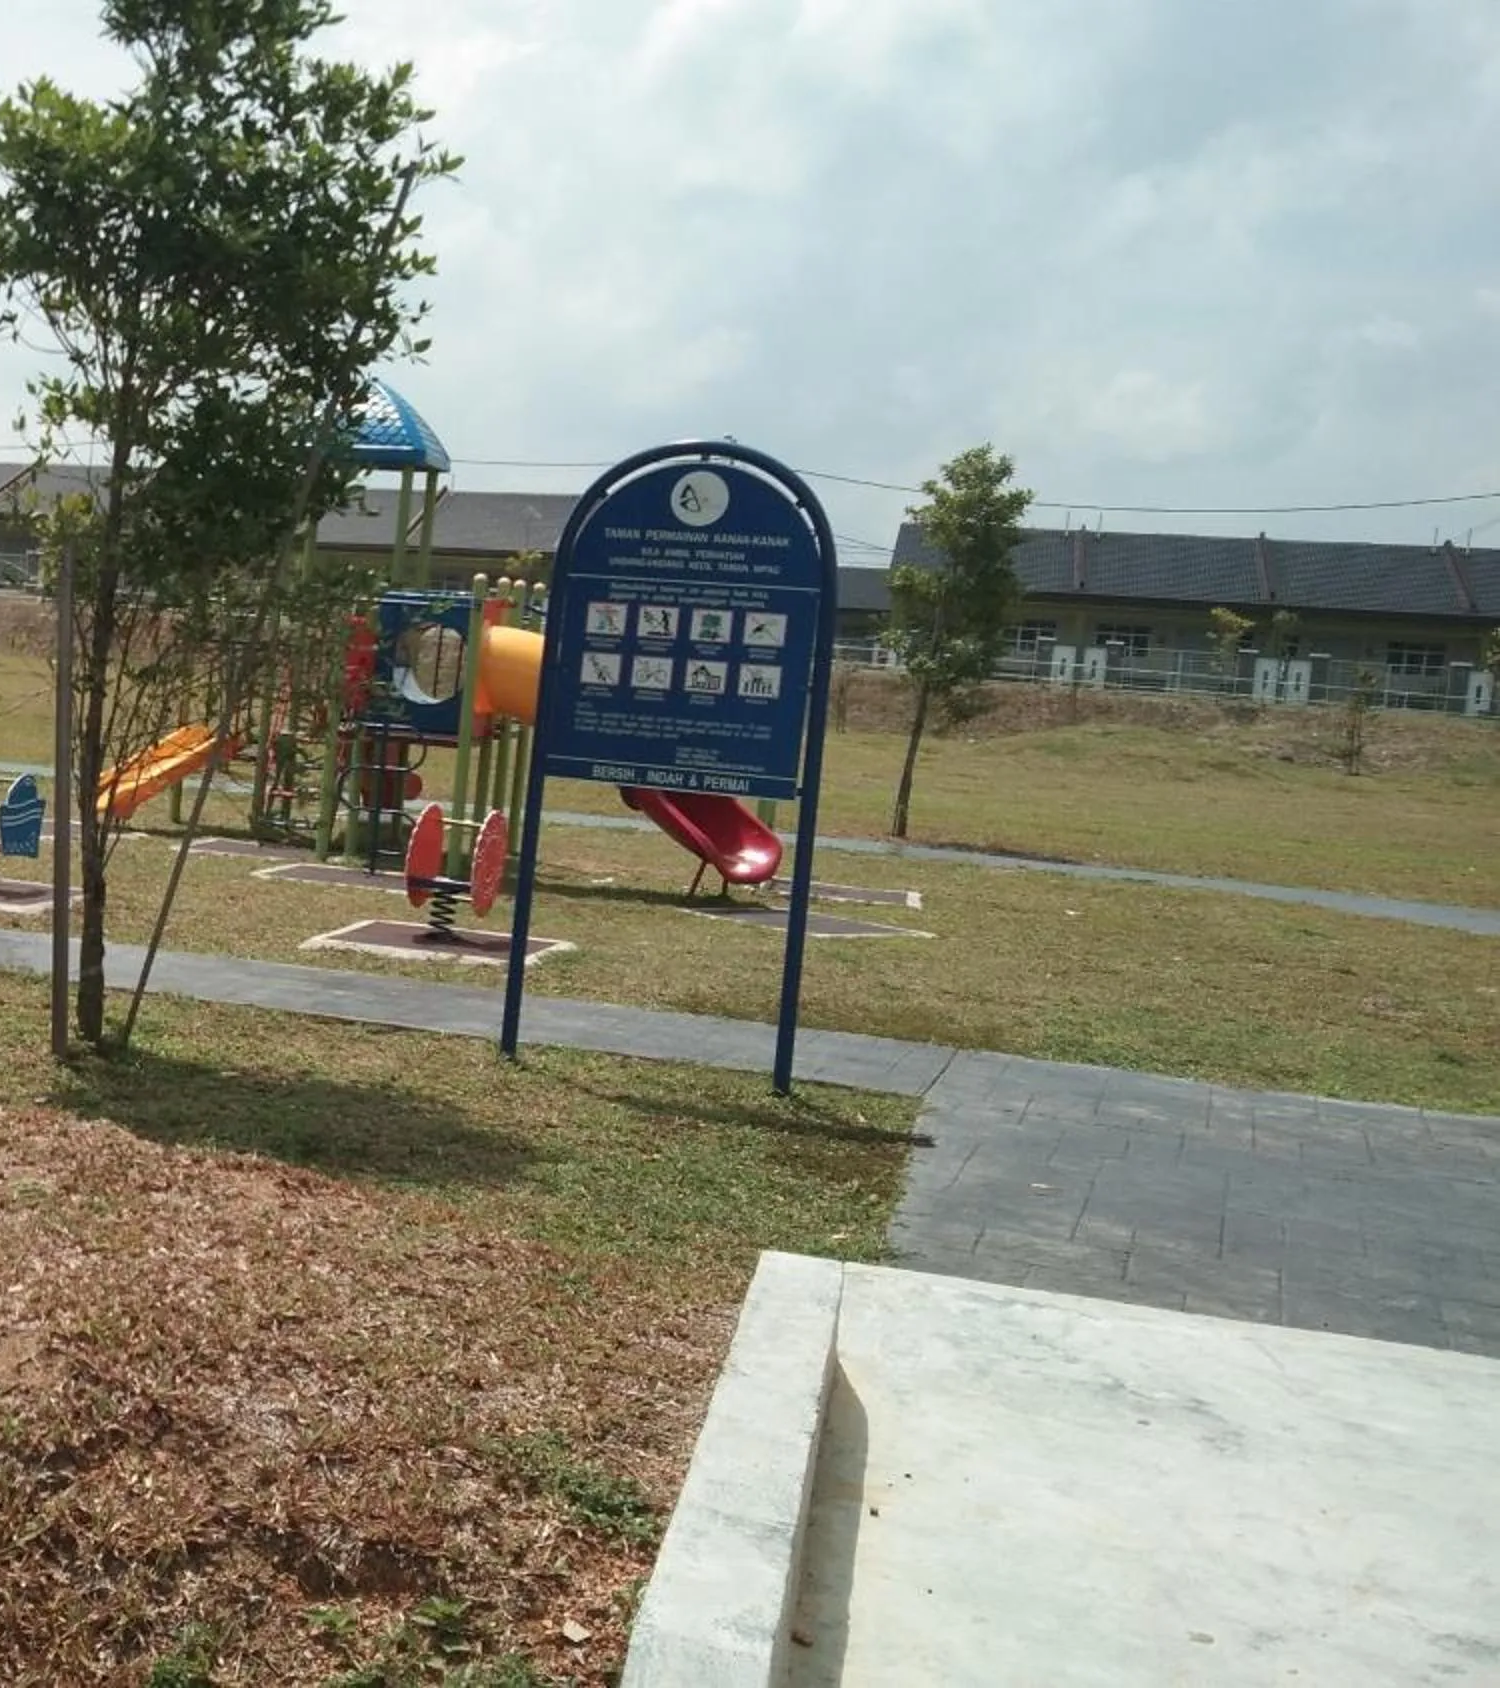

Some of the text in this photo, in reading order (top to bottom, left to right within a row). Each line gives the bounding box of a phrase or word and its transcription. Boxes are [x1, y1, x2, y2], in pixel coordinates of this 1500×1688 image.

[605, 527, 641, 539] TAMAN
[647, 769, 684, 786] INDAH
[689, 775, 697, 787] &
[703, 775, 750, 793] PERMAI
